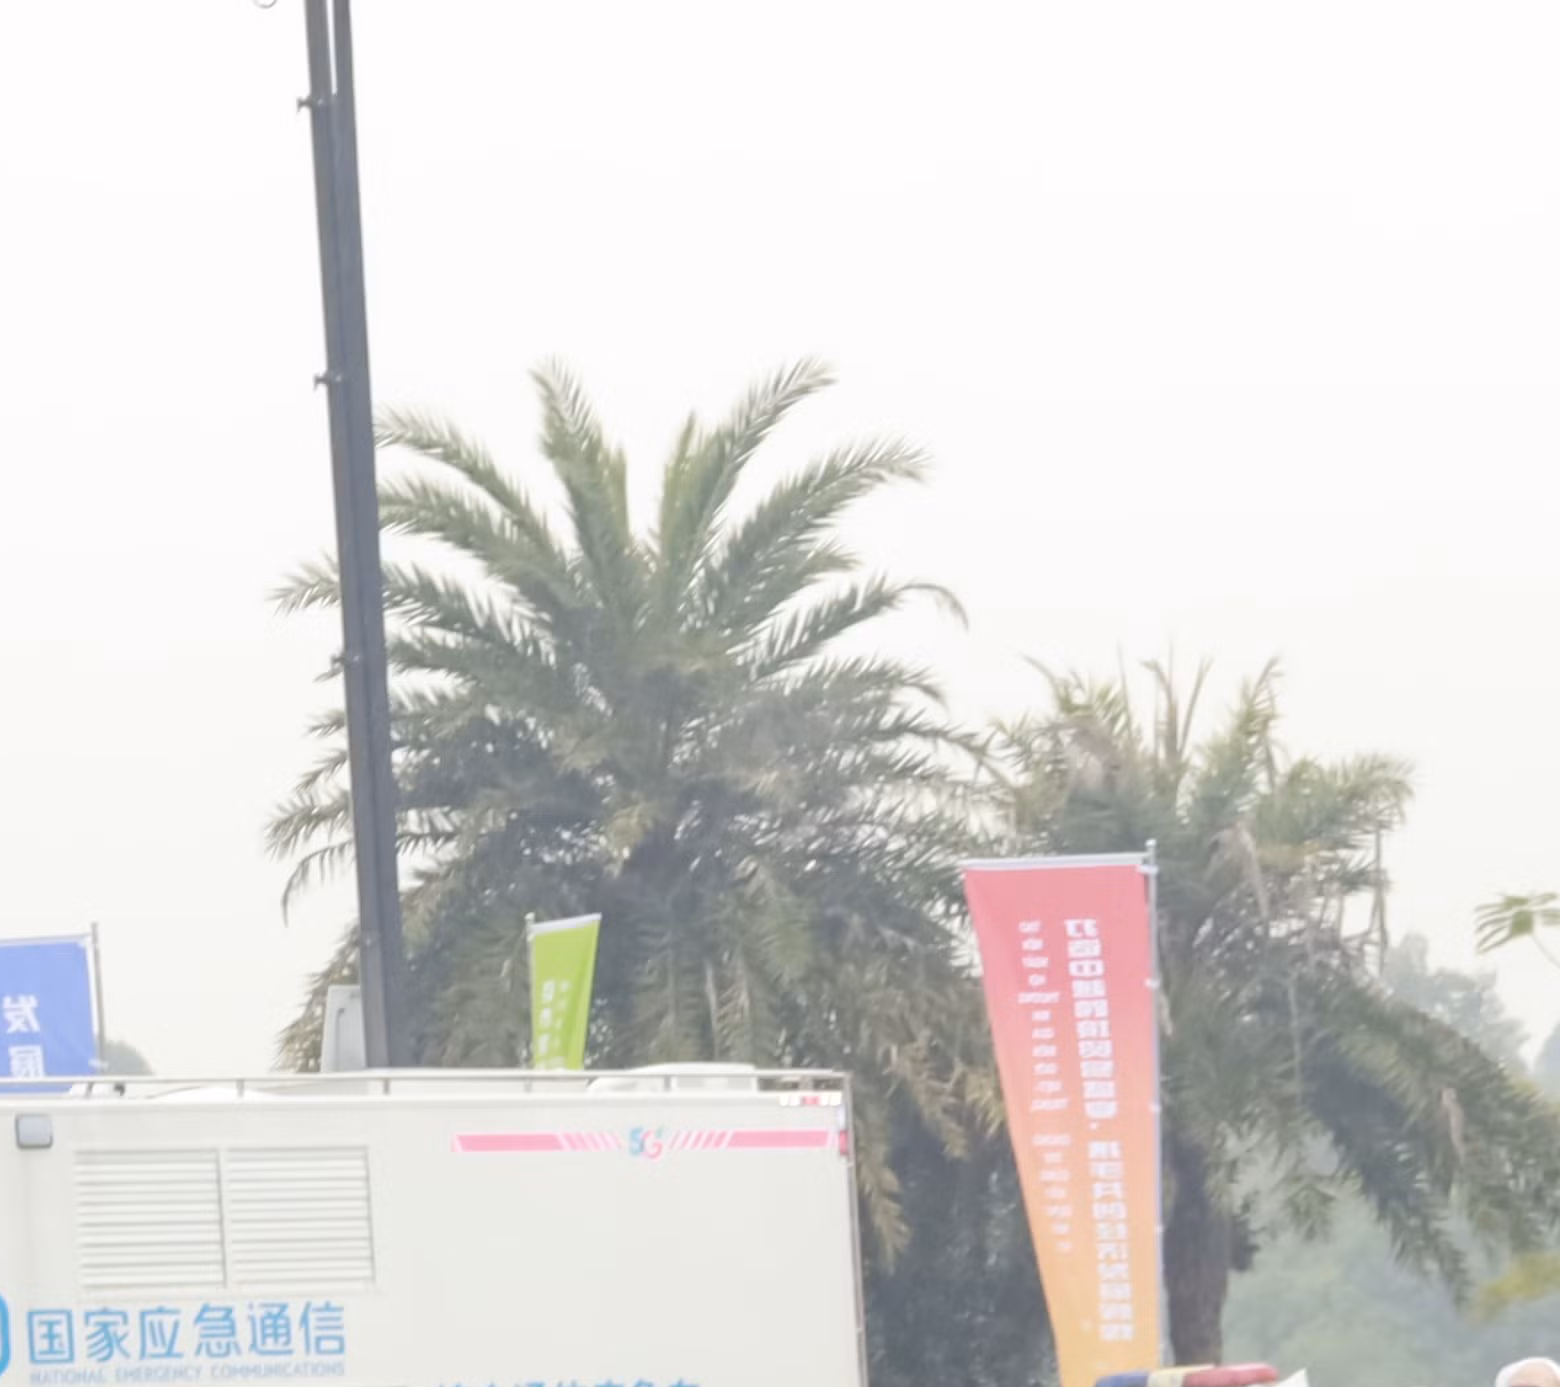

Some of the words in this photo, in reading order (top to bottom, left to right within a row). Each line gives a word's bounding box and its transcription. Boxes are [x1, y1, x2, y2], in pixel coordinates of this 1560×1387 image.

[26, 1301, 345, 1363] 国家应急通信
[30, 1367, 106, 1385] NATIONAL
[115, 1364, 200, 1382] EMERGENCY
[209, 1360, 344, 1379] COMMUNICATIONS
